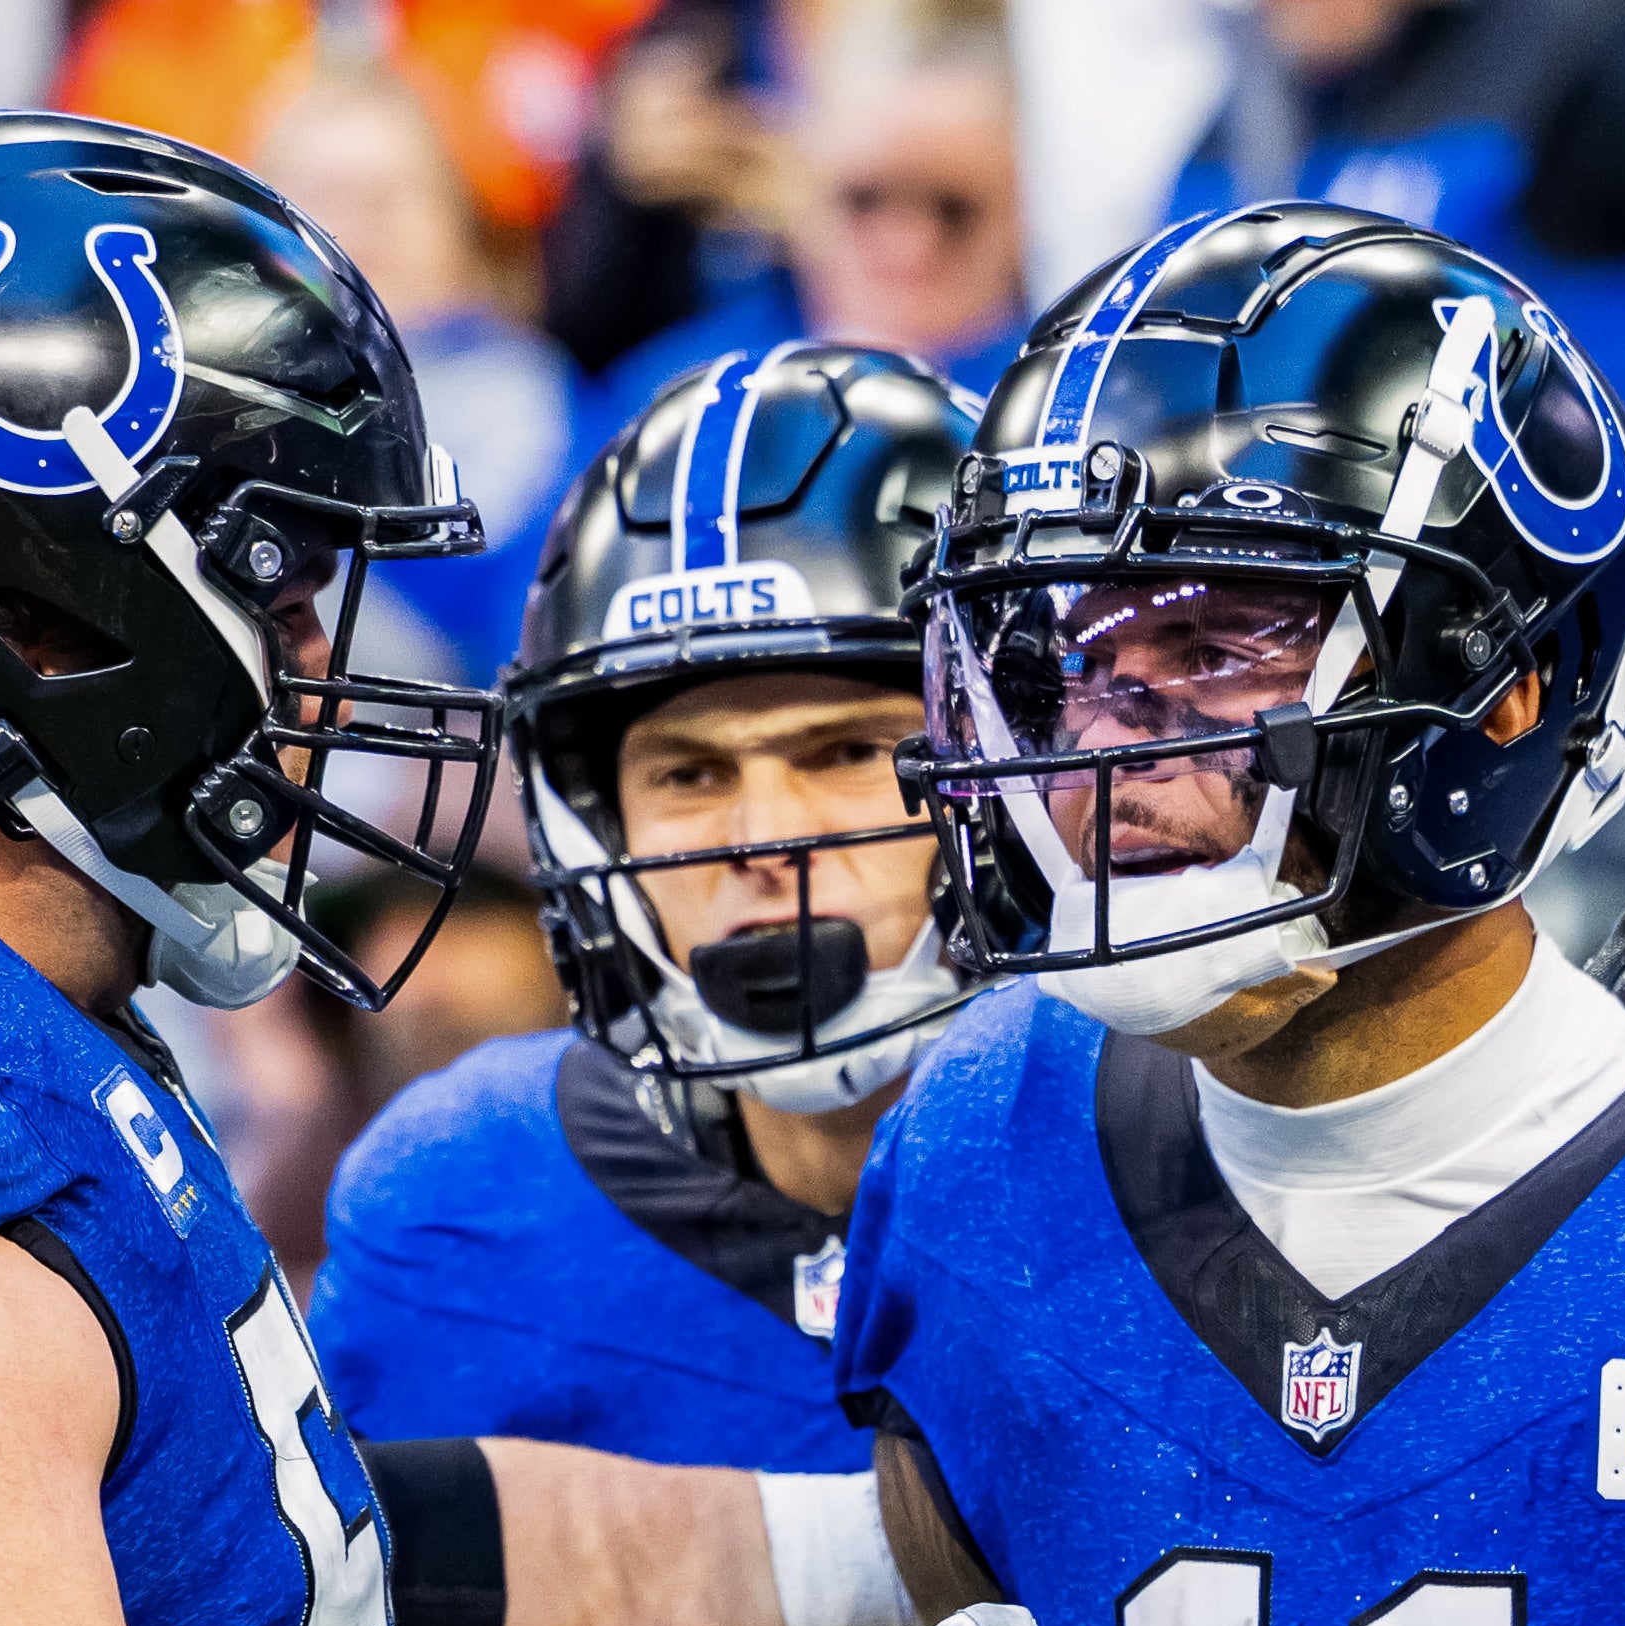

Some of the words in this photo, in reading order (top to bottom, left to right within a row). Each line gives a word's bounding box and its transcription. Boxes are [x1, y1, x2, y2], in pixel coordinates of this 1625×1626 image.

[630, 577, 776, 631] COLTS
[105, 1079, 185, 1195] C
[1292, 1381, 1341, 1421] NFL
